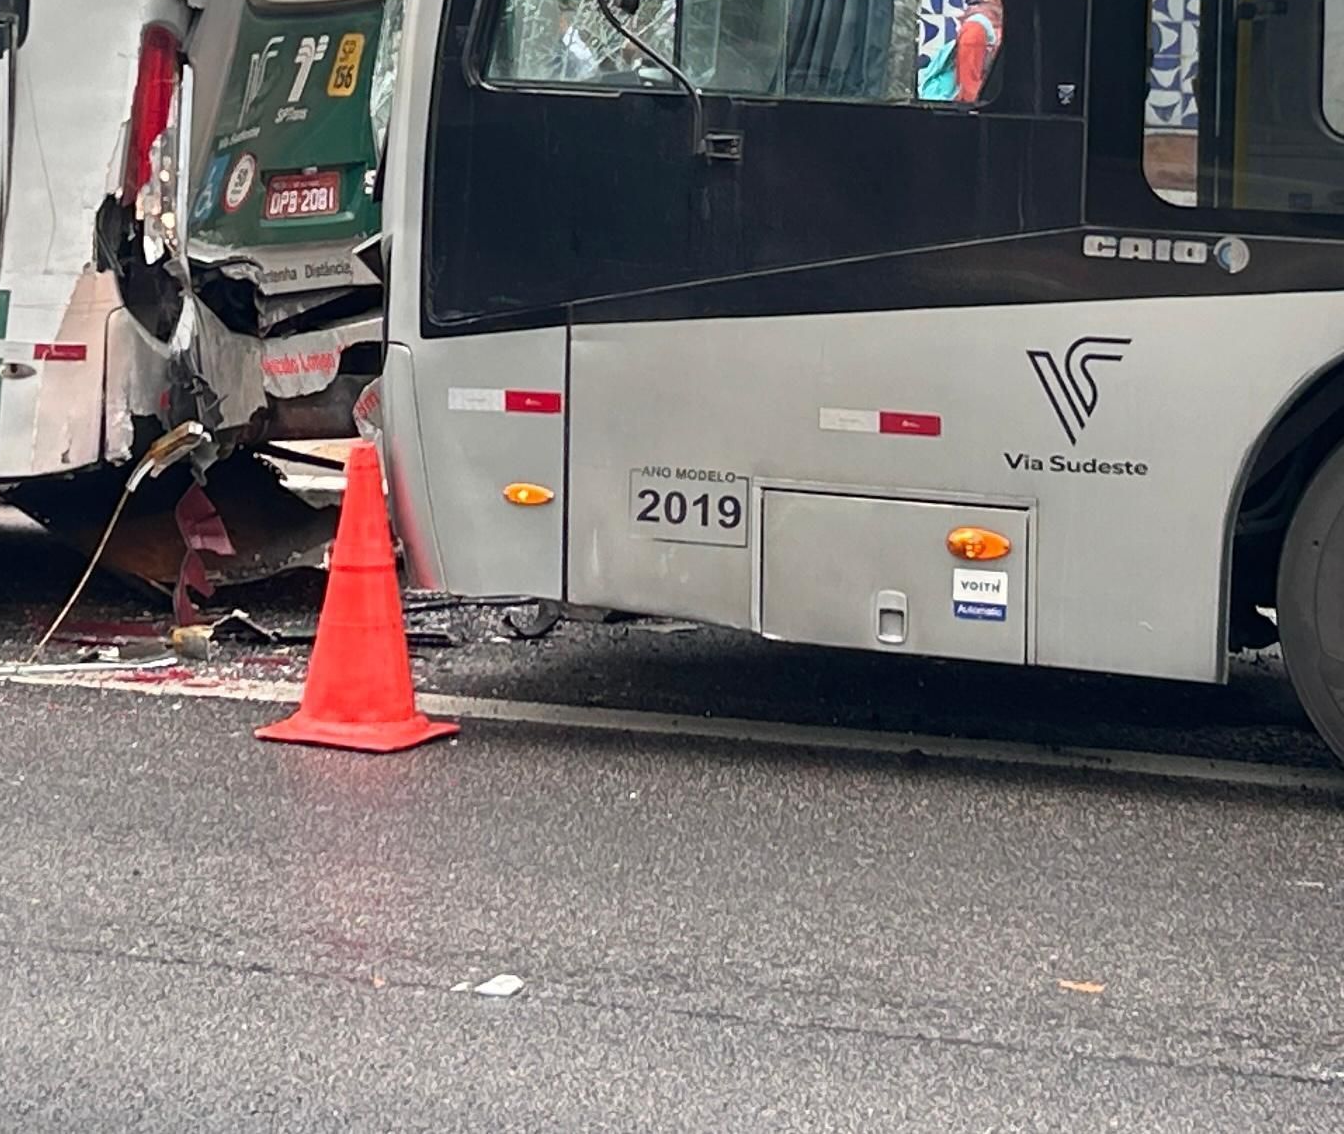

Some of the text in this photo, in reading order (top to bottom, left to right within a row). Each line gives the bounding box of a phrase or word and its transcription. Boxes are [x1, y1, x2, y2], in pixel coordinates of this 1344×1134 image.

[1082, 235, 1208, 264] CAIO
[641, 465, 738, 483] ANO MODELO
[1004, 452, 1149, 476] Via Sudeste
[636, 489, 742, 530] 2019
[960, 579, 1001, 594] VOITH
